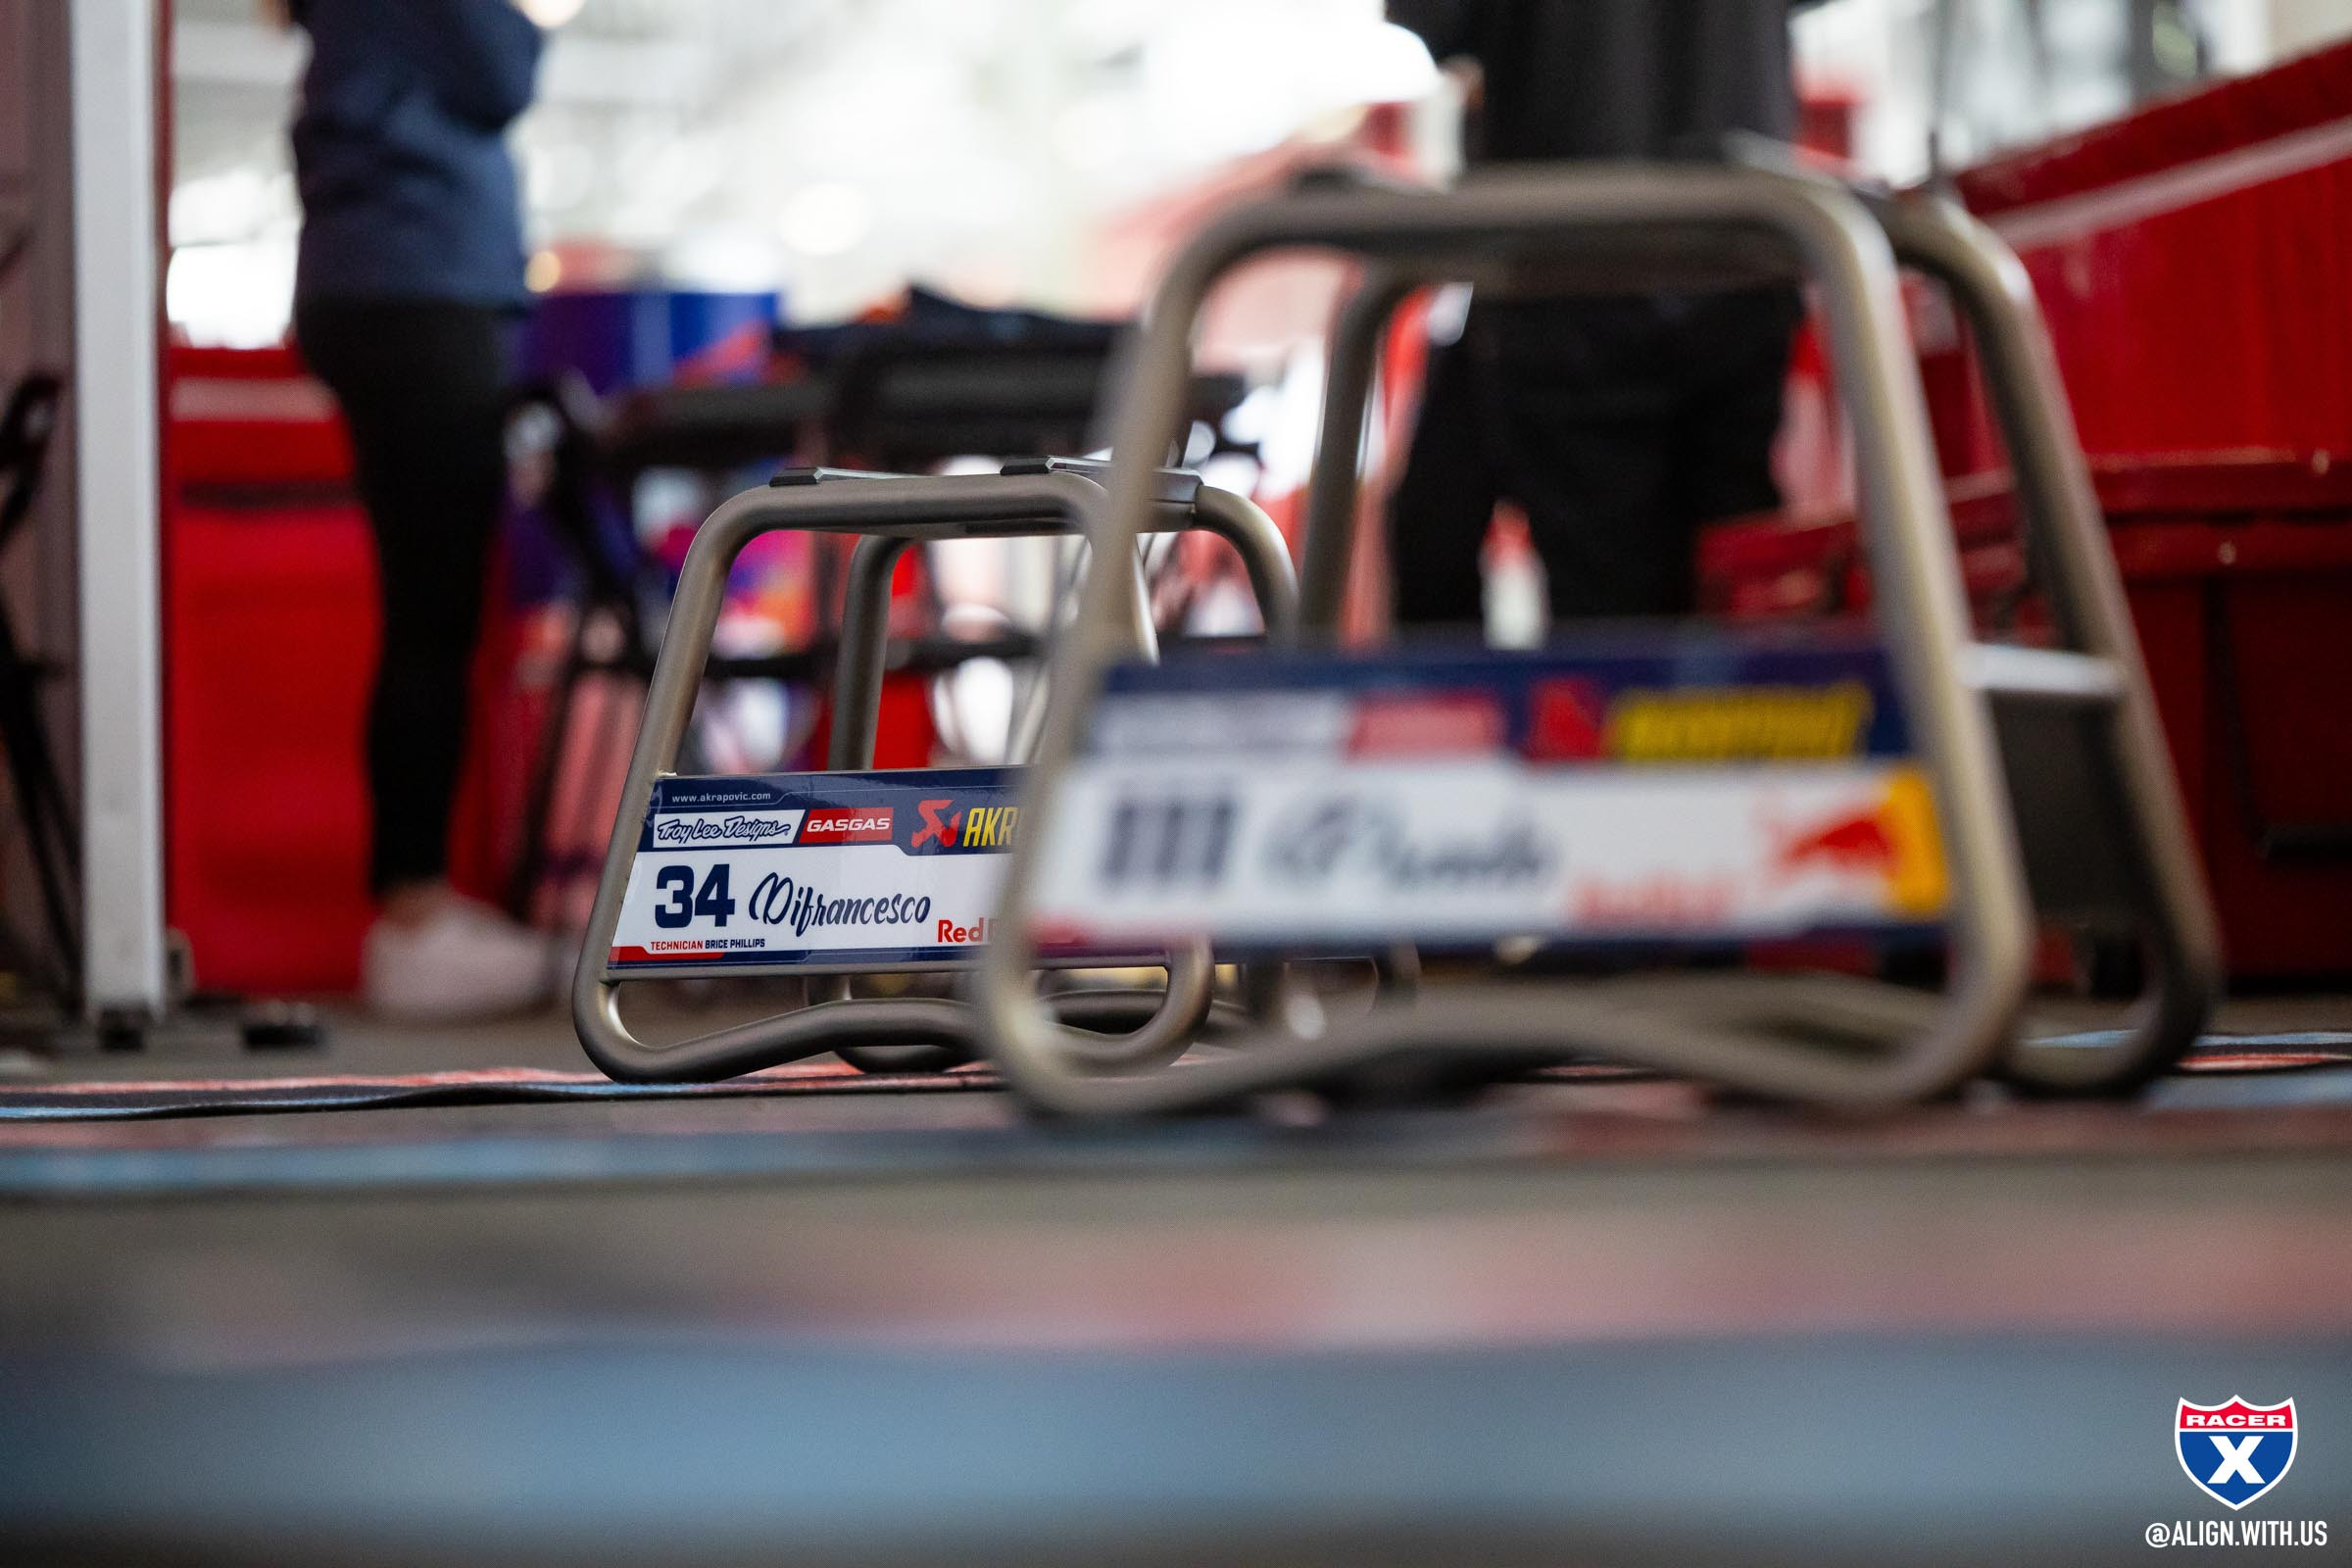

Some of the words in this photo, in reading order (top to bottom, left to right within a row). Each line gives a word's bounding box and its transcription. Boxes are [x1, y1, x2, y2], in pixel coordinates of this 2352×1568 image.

[671, 791, 771, 803] www.akrapovic.com
[658, 819, 693, 844] Troy
[692, 818, 721, 839] Lee
[723, 815, 791, 842] Designs
[807, 817, 891, 833] GASGAS
[655, 863, 736, 929] 34
[748, 872, 931, 937] Difrancesco
[651, 941, 704, 951] TECHNICIAN
[705, 940, 728, 950] BRICE
[729, 938, 765, 949] PHILLIPS
